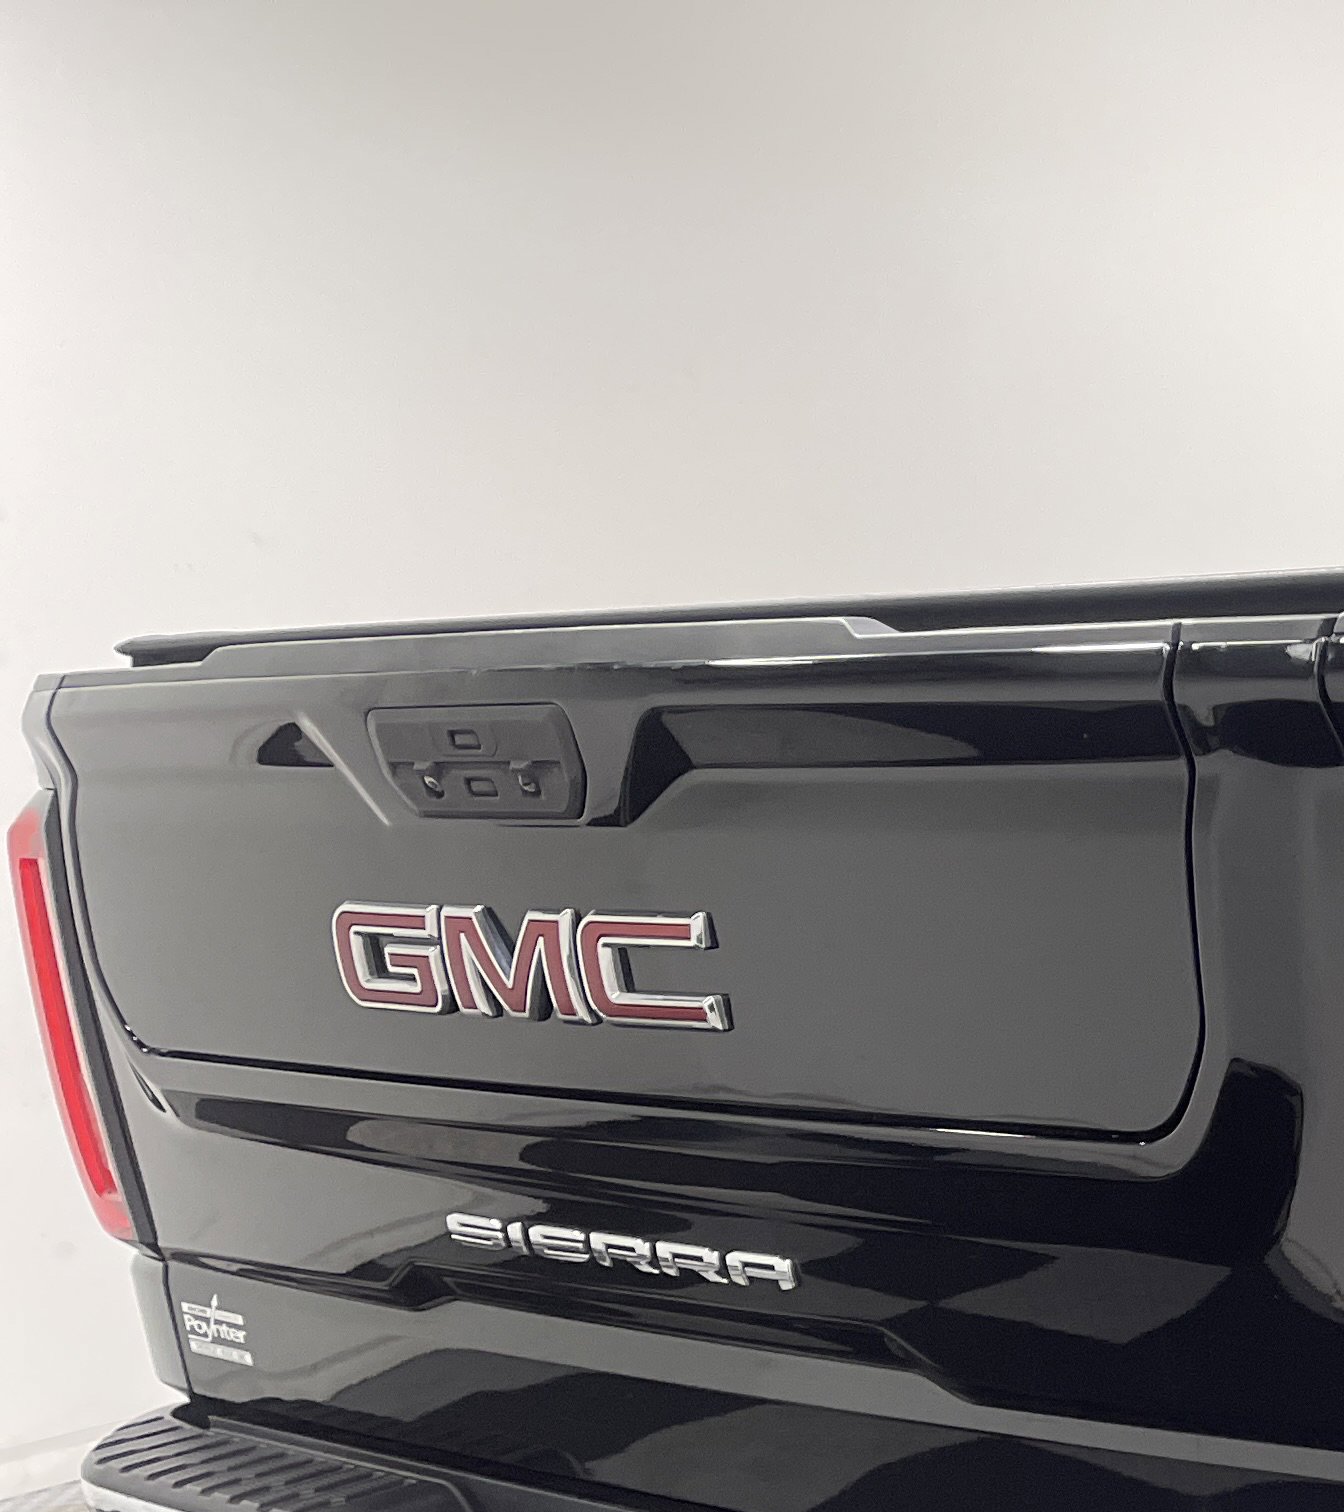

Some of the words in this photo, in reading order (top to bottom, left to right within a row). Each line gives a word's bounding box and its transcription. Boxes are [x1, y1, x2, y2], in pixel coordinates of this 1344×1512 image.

[332, 901, 734, 1031] GMC
[446, 1212, 797, 1292] SIERRA
[183, 1312, 247, 1344] Poynter
